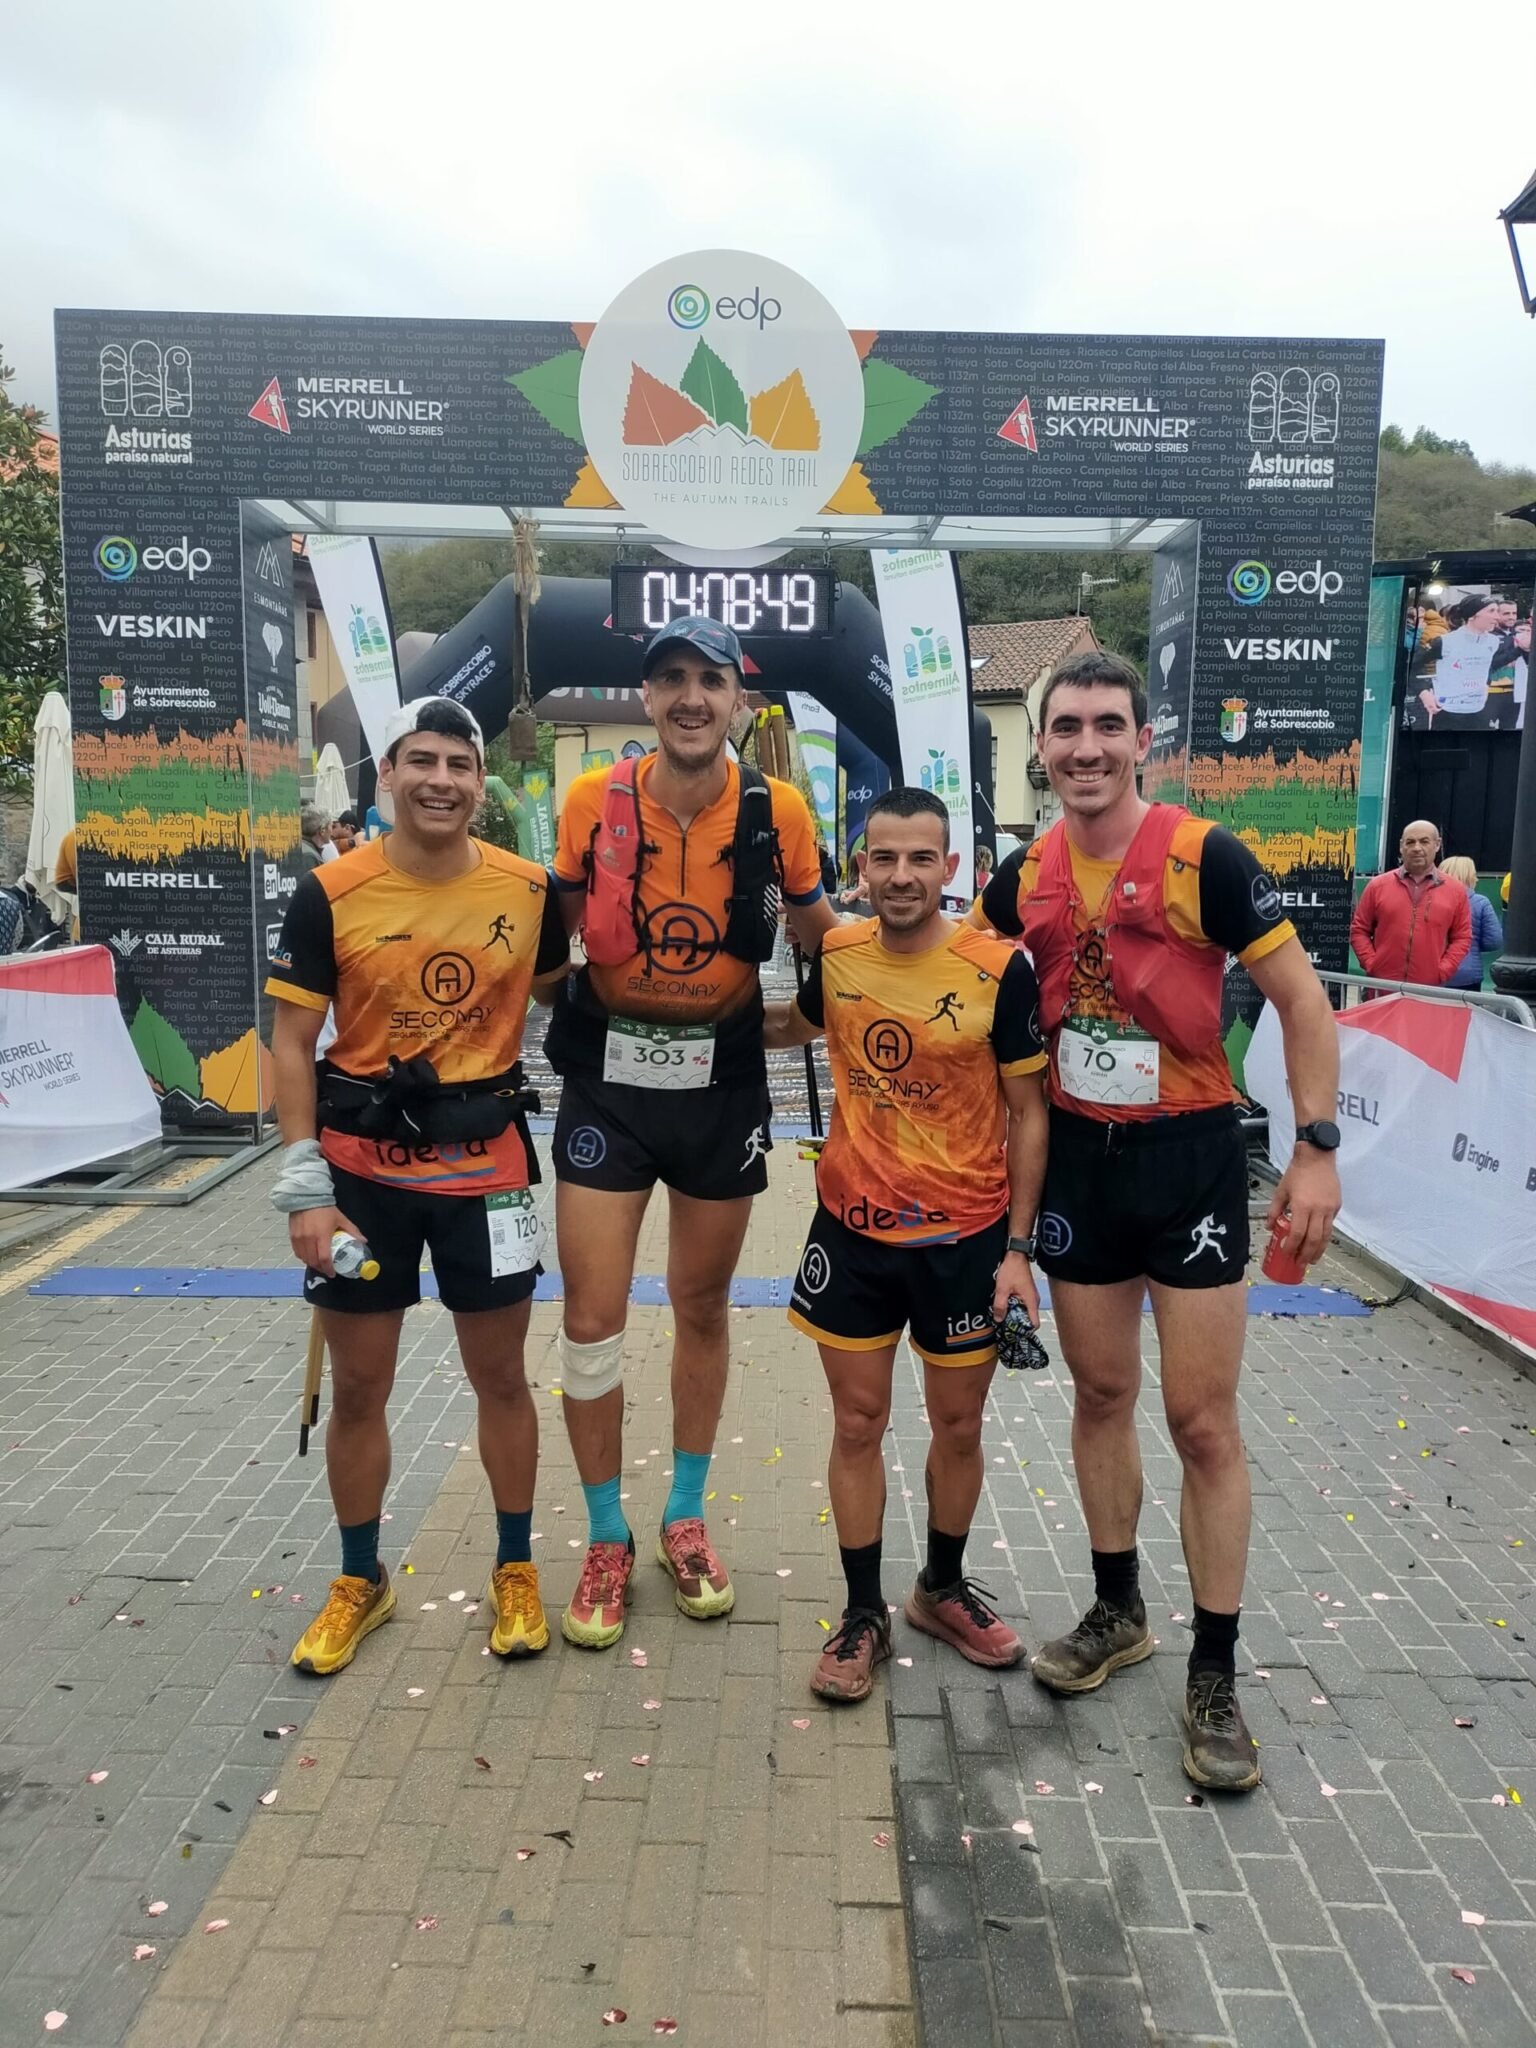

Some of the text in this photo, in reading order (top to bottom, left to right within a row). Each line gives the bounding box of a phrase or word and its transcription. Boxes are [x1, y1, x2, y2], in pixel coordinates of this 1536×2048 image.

[715, 286, 782, 330] edp
[297, 376, 412, 395] MERRELL
[1046, 396, 1160, 413] MERRELL
[104, 424, 193, 449] Asturias
[368, 425, 444, 437] WORLD SERIES
[1114, 442, 1189, 453] WORLD SERIES
[105, 451, 193, 464] paraíso natural
[1249, 450, 1335, 475] Asturias
[622, 452, 818, 487] SOBRESCOBIO REDES TRAIL
[1248, 476, 1334, 490] paraíso natural
[653, 493, 788, 506] THE AUTUMN TRAILS
[142, 536, 212, 581] edp
[1275, 559, 1343, 604] edp
[643, 571, 815, 632] 04:08:49
[438, 645, 491, 698] SOBRESCOBIO
[132, 685, 210, 699] Ayuntamiento
[133, 697, 217, 708] de Sobrescobio
[1254, 707, 1330, 719] Ayuntamiento
[1254, 719, 1335, 729] de Sobrescobio
[847, 785, 873, 804] edp
[104, 872, 223, 889] MERRELL
[145, 933, 224, 946] CAJA RURAL
[147, 946, 202, 955] DE ASTURIAS
[627, 976, 722, 997] SECONAY
[389, 1006, 496, 1029] SECONAY
[633, 1046, 685, 1065] 303
[1083, 1047, 1116, 1072] 70
[848, 1068, 942, 1100] SECONAY
[1467, 1143, 1499, 1172] Engine
[514, 1214, 538, 1239] 120
[947, 1312, 987, 1336] ide
